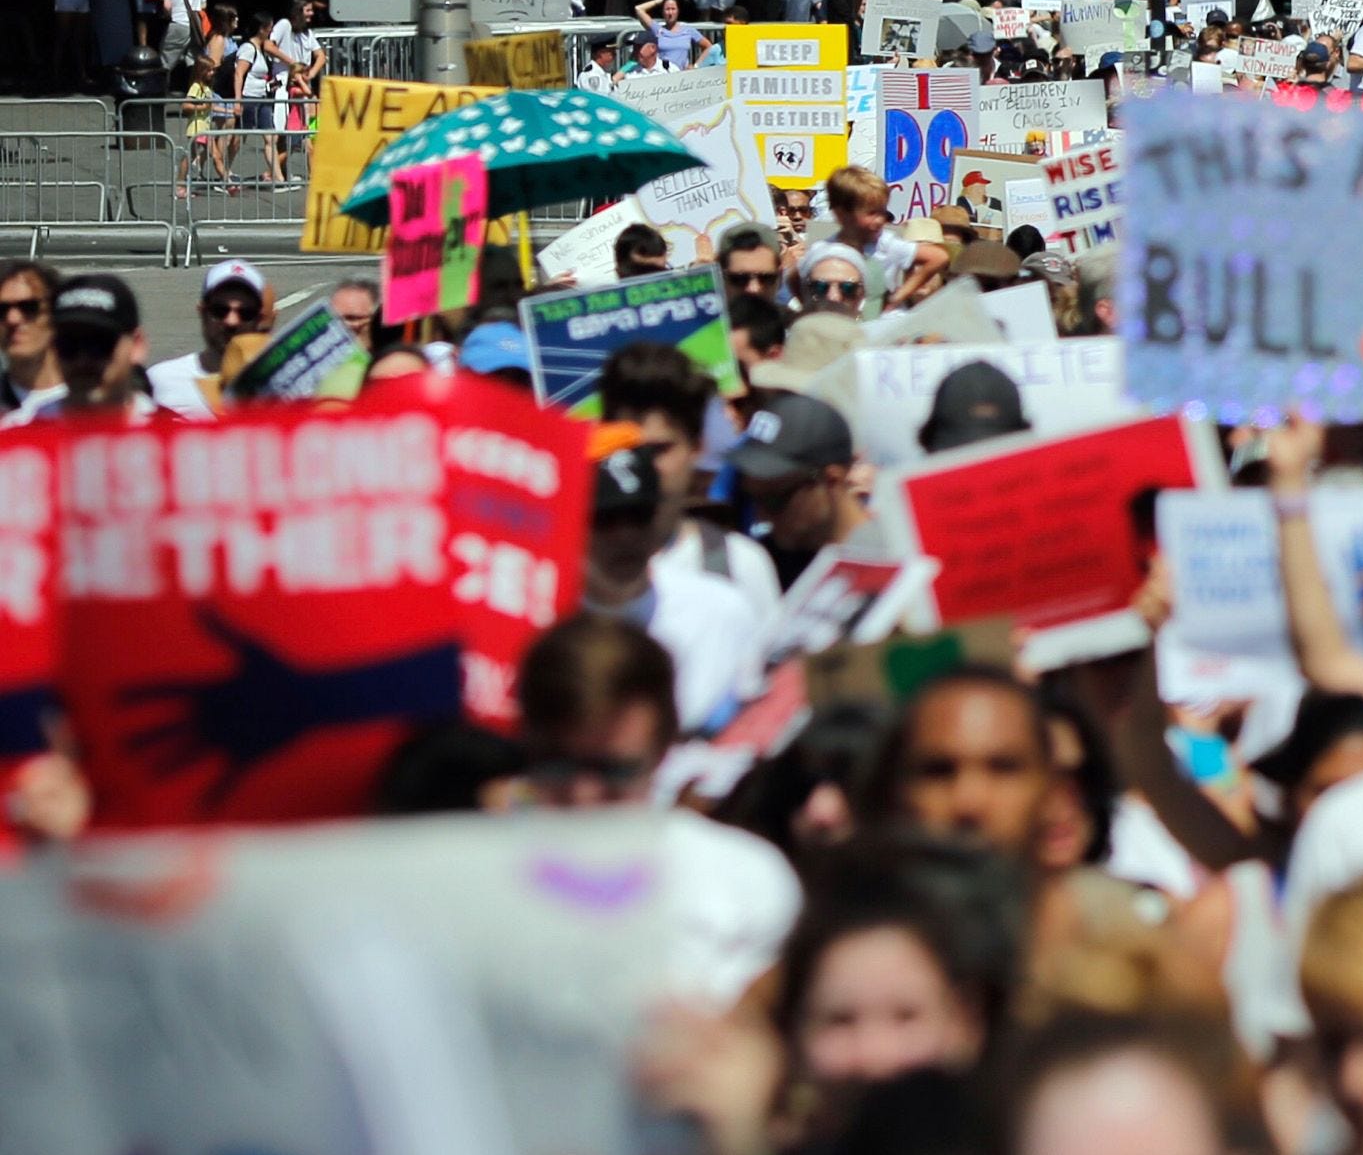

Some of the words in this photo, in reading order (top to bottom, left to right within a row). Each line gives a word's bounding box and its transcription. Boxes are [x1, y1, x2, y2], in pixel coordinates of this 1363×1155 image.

[765, 44, 812, 60] KEEP
[1256, 40, 1297, 56] TRUMP
[739, 76, 833, 95] FAMILIES
[915, 73, 930, 110] I
[1000, 83, 1068, 100] CHILDREN
[328, 80, 408, 133] WE
[750, 111, 840, 128] OGETHER!
[978, 101, 999, 112] ONT
[1006, 98, 1050, 110] BELONG
[1059, 97, 1081, 108] IN
[1012, 112, 1065, 129] CAGES
[885, 108, 968, 184] DO
[1137, 118, 1331, 200] THIS
[1043, 148, 1118, 185] WISE
[673, 189, 710, 214] THAN
[888, 182, 947, 225] CAR
[1054, 180, 1125, 220] RISE
[1059, 217, 1123, 254] TIM
[1142, 244, 1341, 358] BULL
